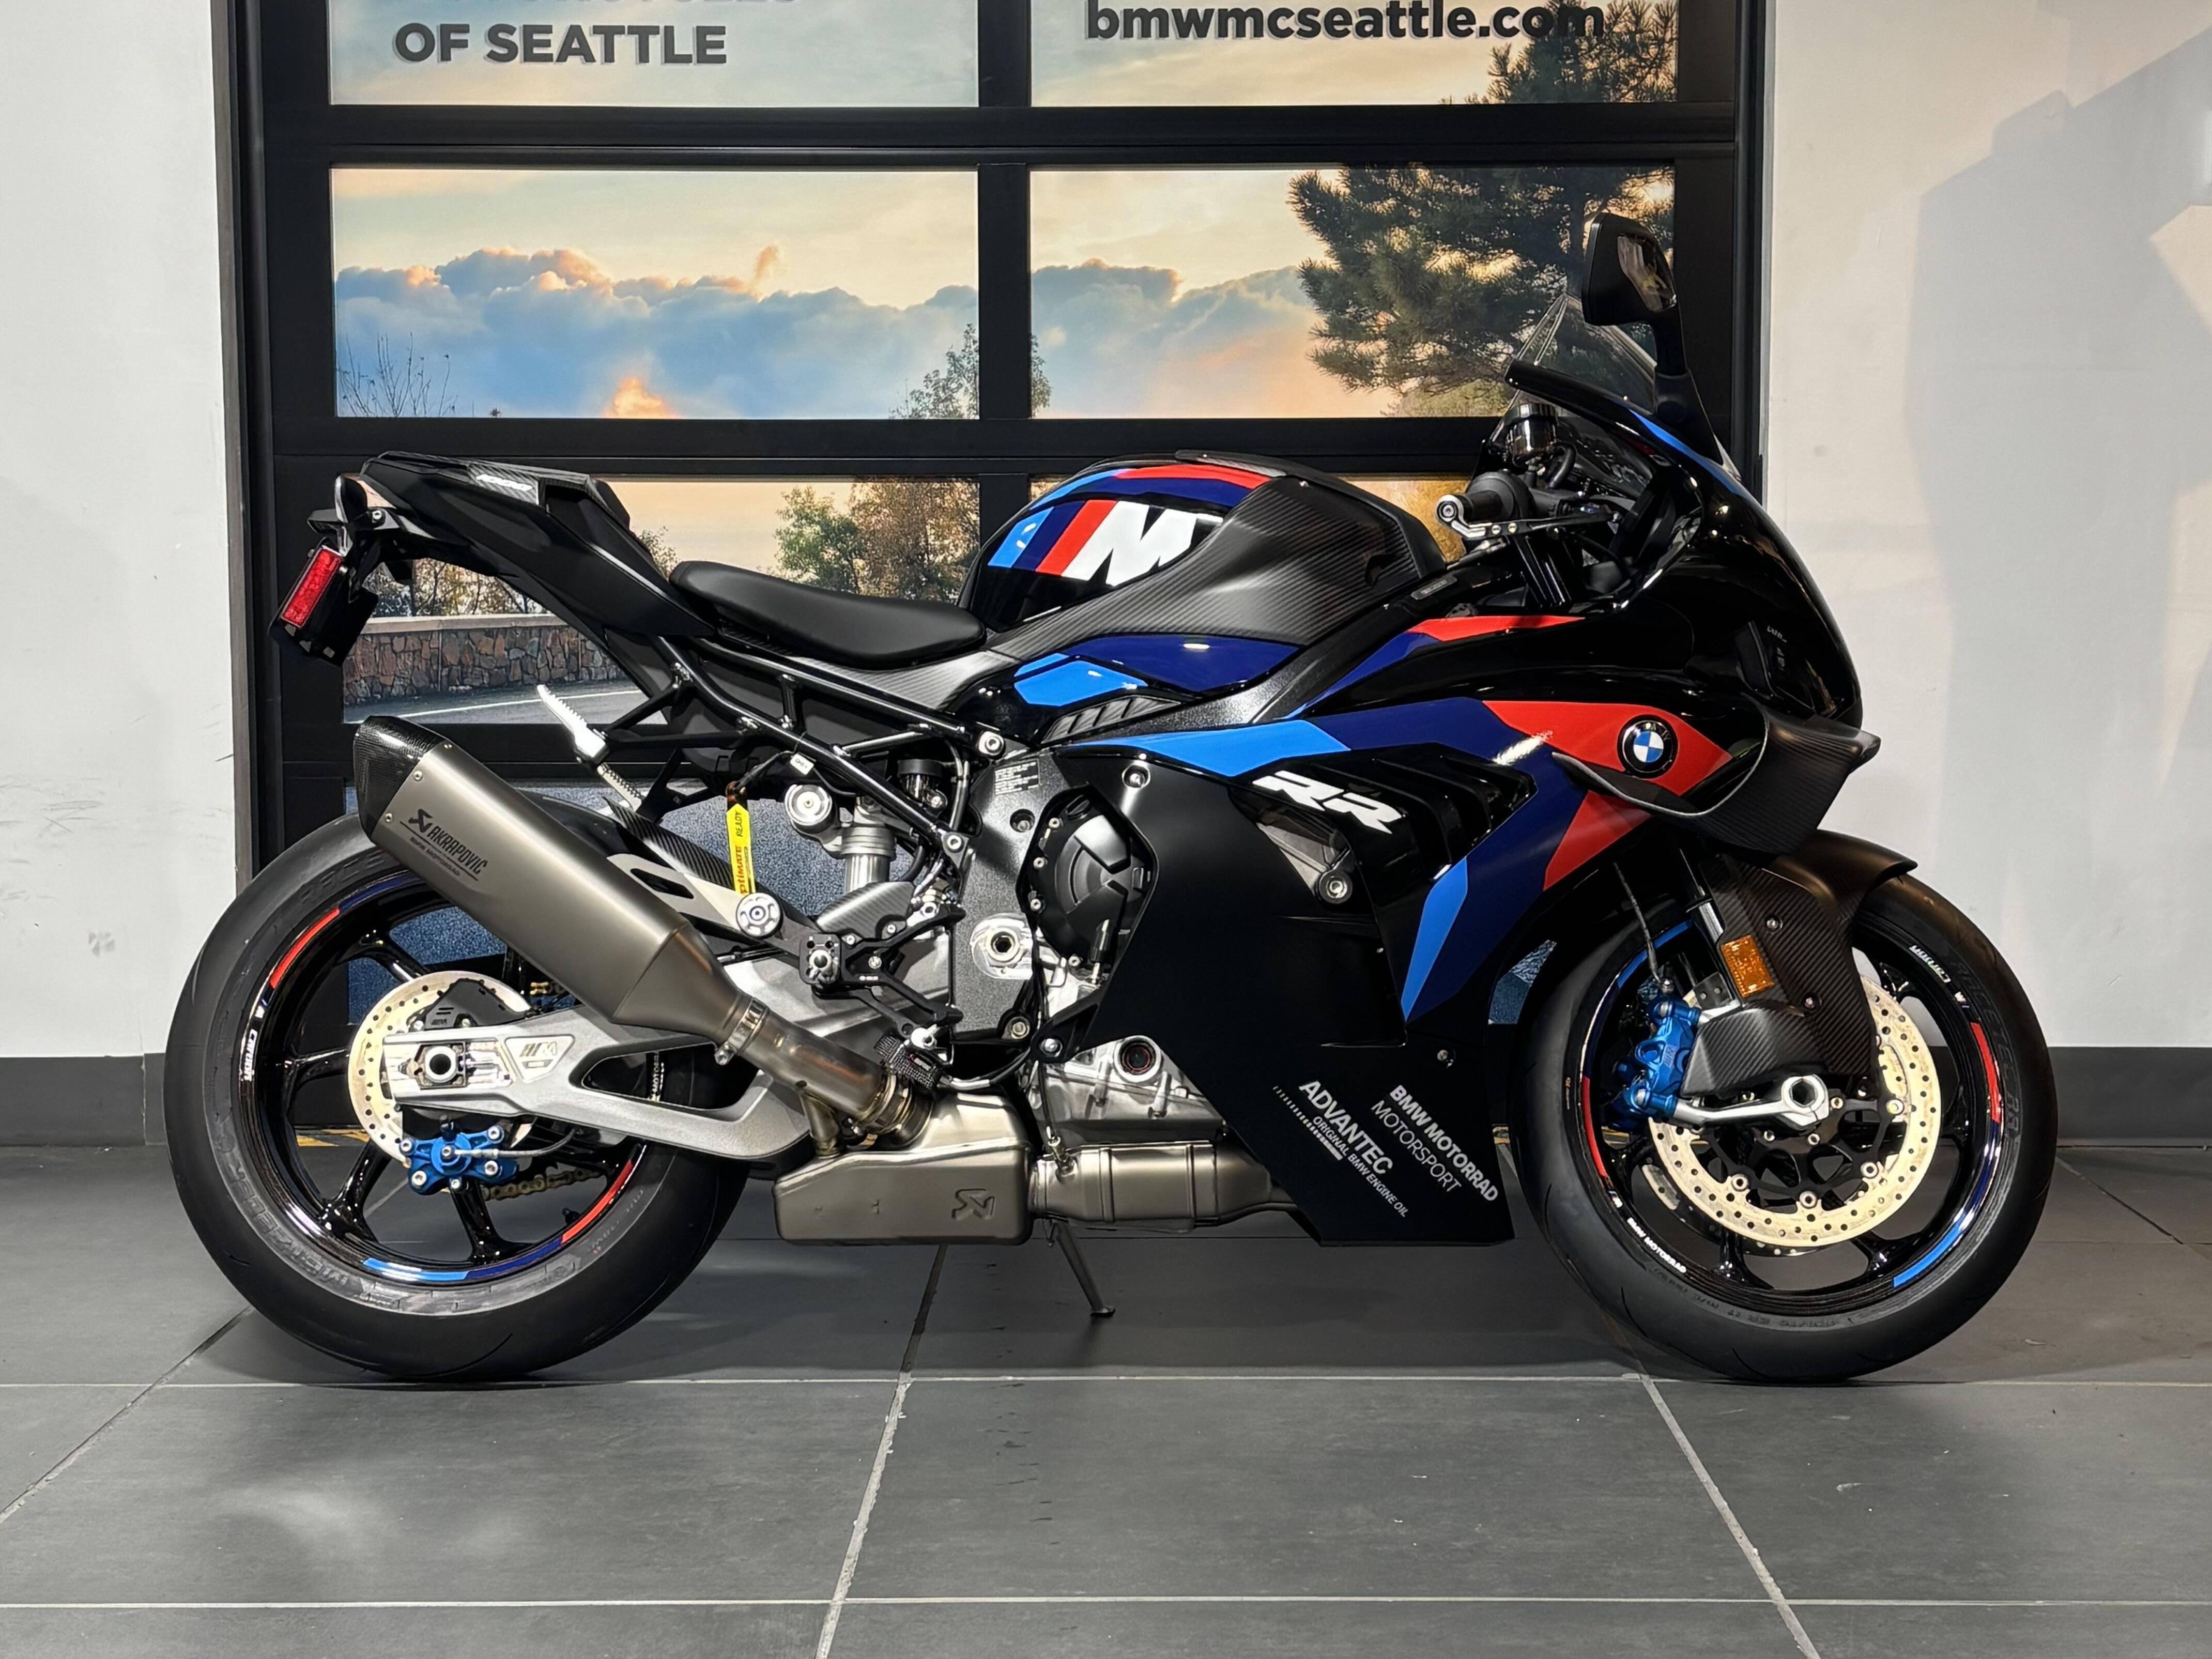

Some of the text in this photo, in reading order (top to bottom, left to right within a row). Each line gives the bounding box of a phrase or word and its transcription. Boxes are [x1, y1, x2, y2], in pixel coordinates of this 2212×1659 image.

[394, 23, 727, 64] OF SEATTLE
[1087, 0, 1604, 38] bmwmcseattle.com
[735, 810, 744, 838] READY
[1253, 770, 1405, 835] RR
[1298, 1081, 1393, 1174] ADVANTEC
[1313, 1116, 1409, 1218] ORIGINAL BMW ENGINE OIL
[1371, 1099, 1462, 1192] MOTORSPORT
[1389, 1084, 1498, 1201] BMW MOTORRAD
